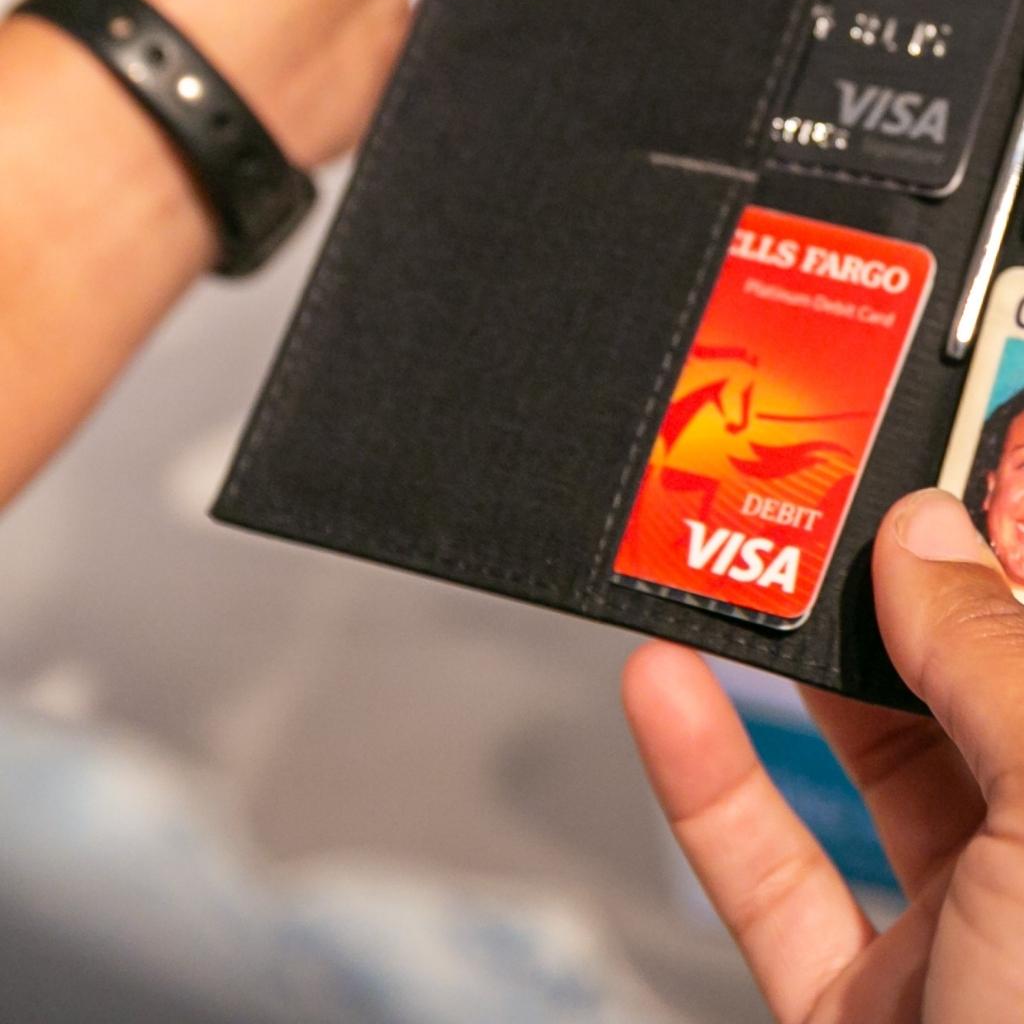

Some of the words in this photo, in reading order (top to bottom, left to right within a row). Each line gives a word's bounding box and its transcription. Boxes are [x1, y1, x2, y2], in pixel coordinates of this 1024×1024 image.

[835, 79, 950, 144] VISA
[800, 245, 909, 294] FARGO
[743, 278, 811, 308] Platinum
[812, 294, 857, 318] Debit
[856, 306, 897, 328] Card
[742, 493, 823, 531] DEBIT
[684, 519, 801, 594] VISA
